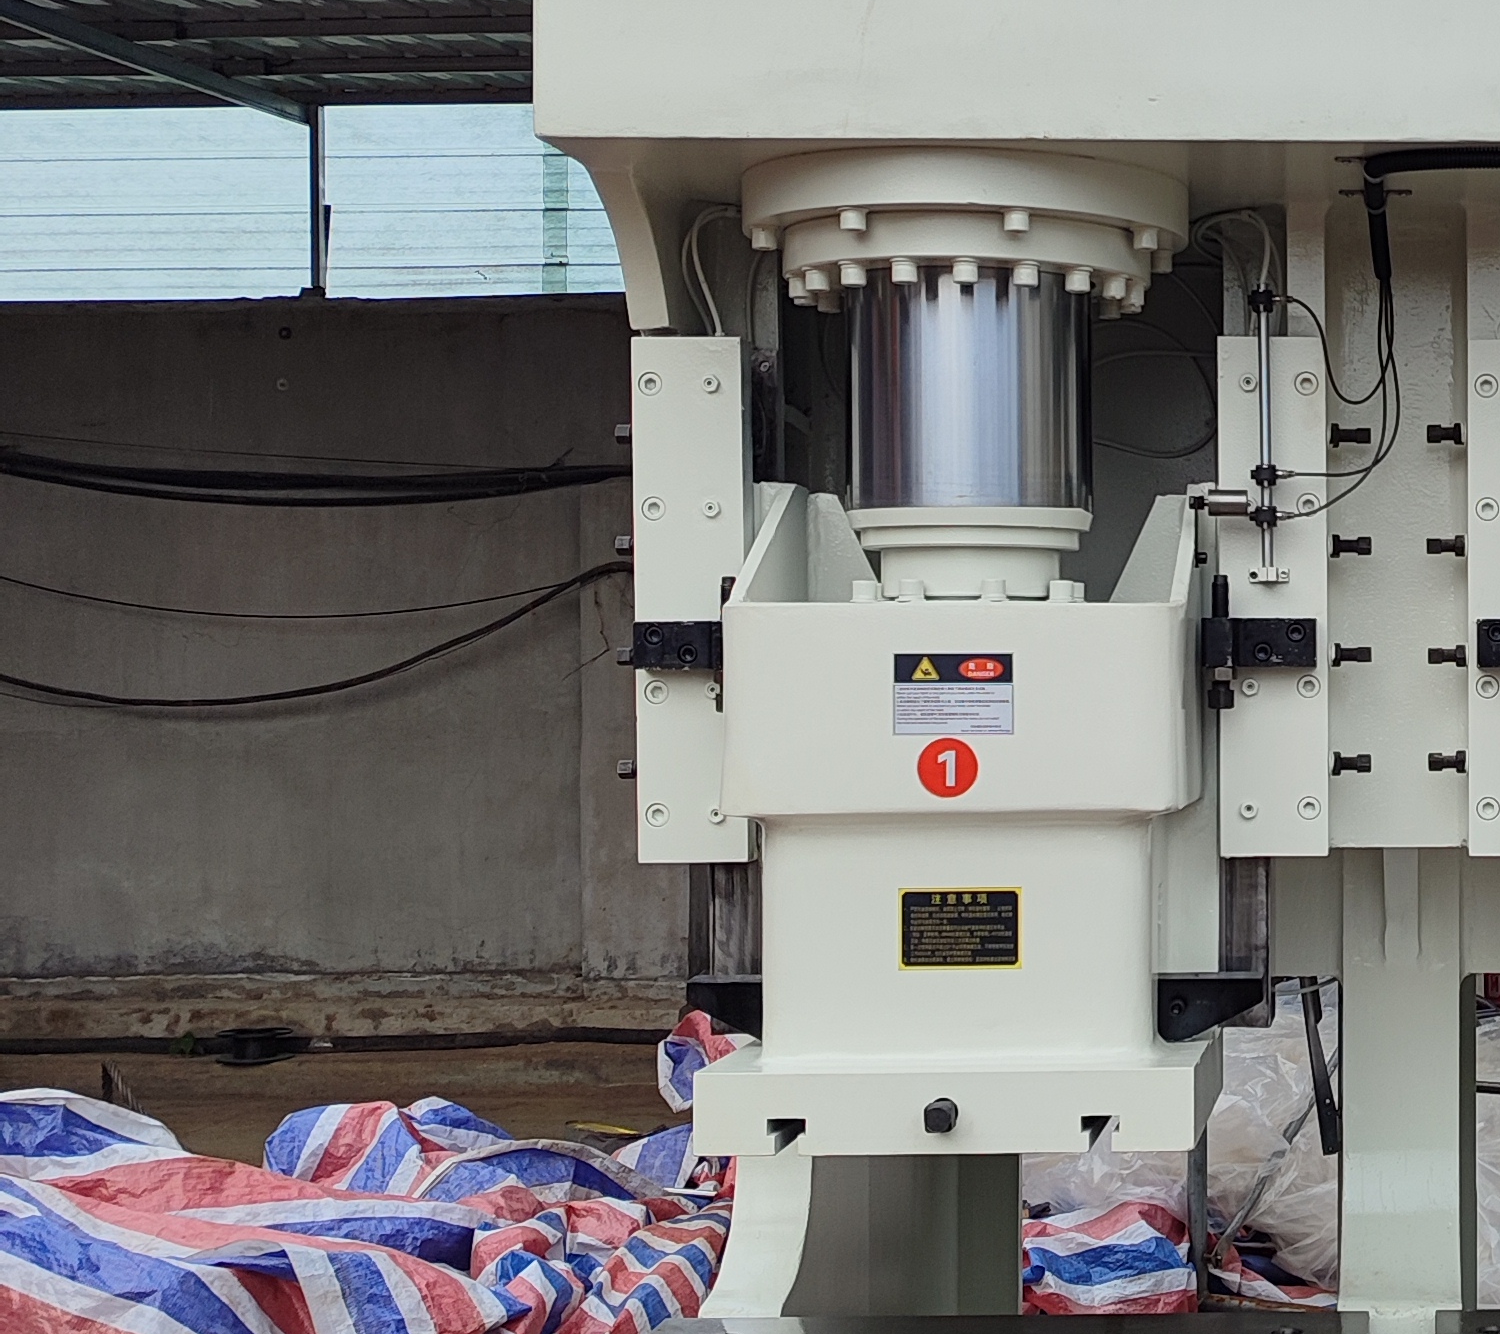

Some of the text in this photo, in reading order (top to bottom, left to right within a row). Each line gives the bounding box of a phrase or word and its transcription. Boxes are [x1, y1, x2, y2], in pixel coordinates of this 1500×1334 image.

[937, 750, 957, 787] 1
[931, 893, 988, 905] 注意事项
